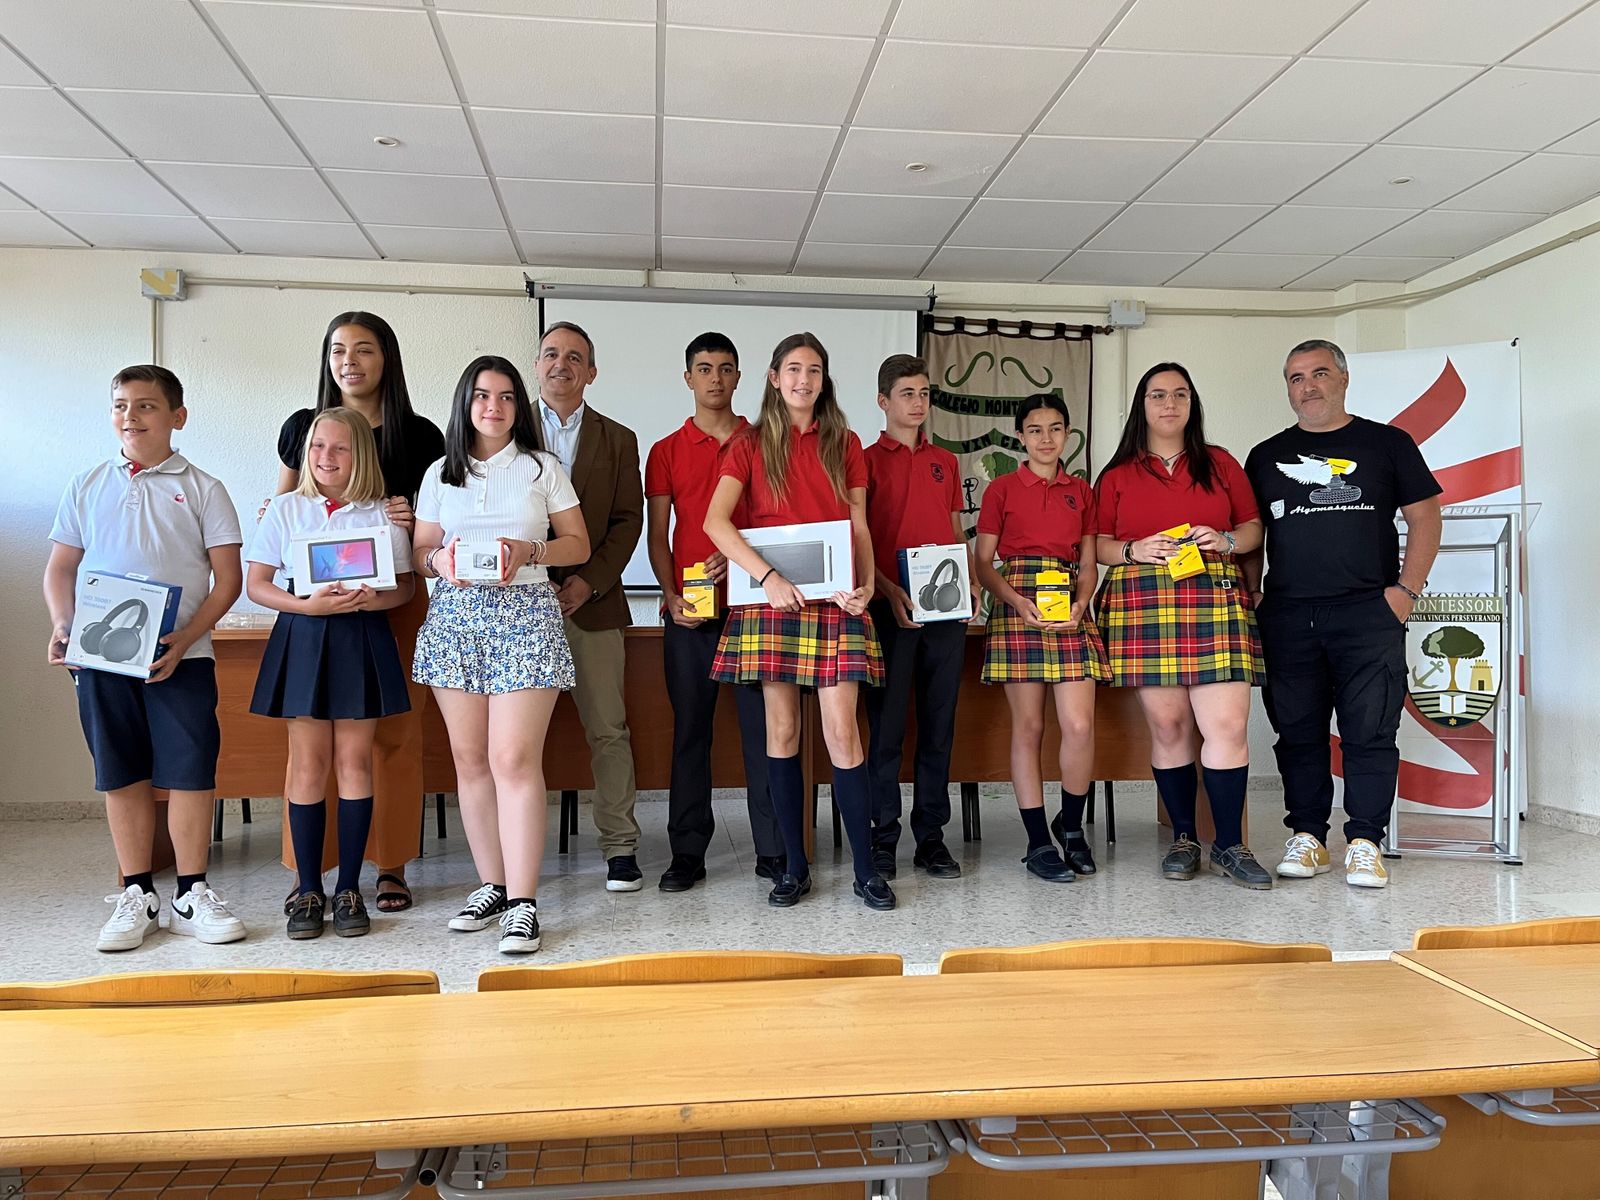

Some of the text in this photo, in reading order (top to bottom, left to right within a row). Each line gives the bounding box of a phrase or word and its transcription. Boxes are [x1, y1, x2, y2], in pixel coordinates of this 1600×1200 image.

[930, 389, 1023, 415] COLEGIO MONT
[1427, 614, 1450, 622] VINCES
[1451, 614, 1501, 622] PERSEVERANDO
